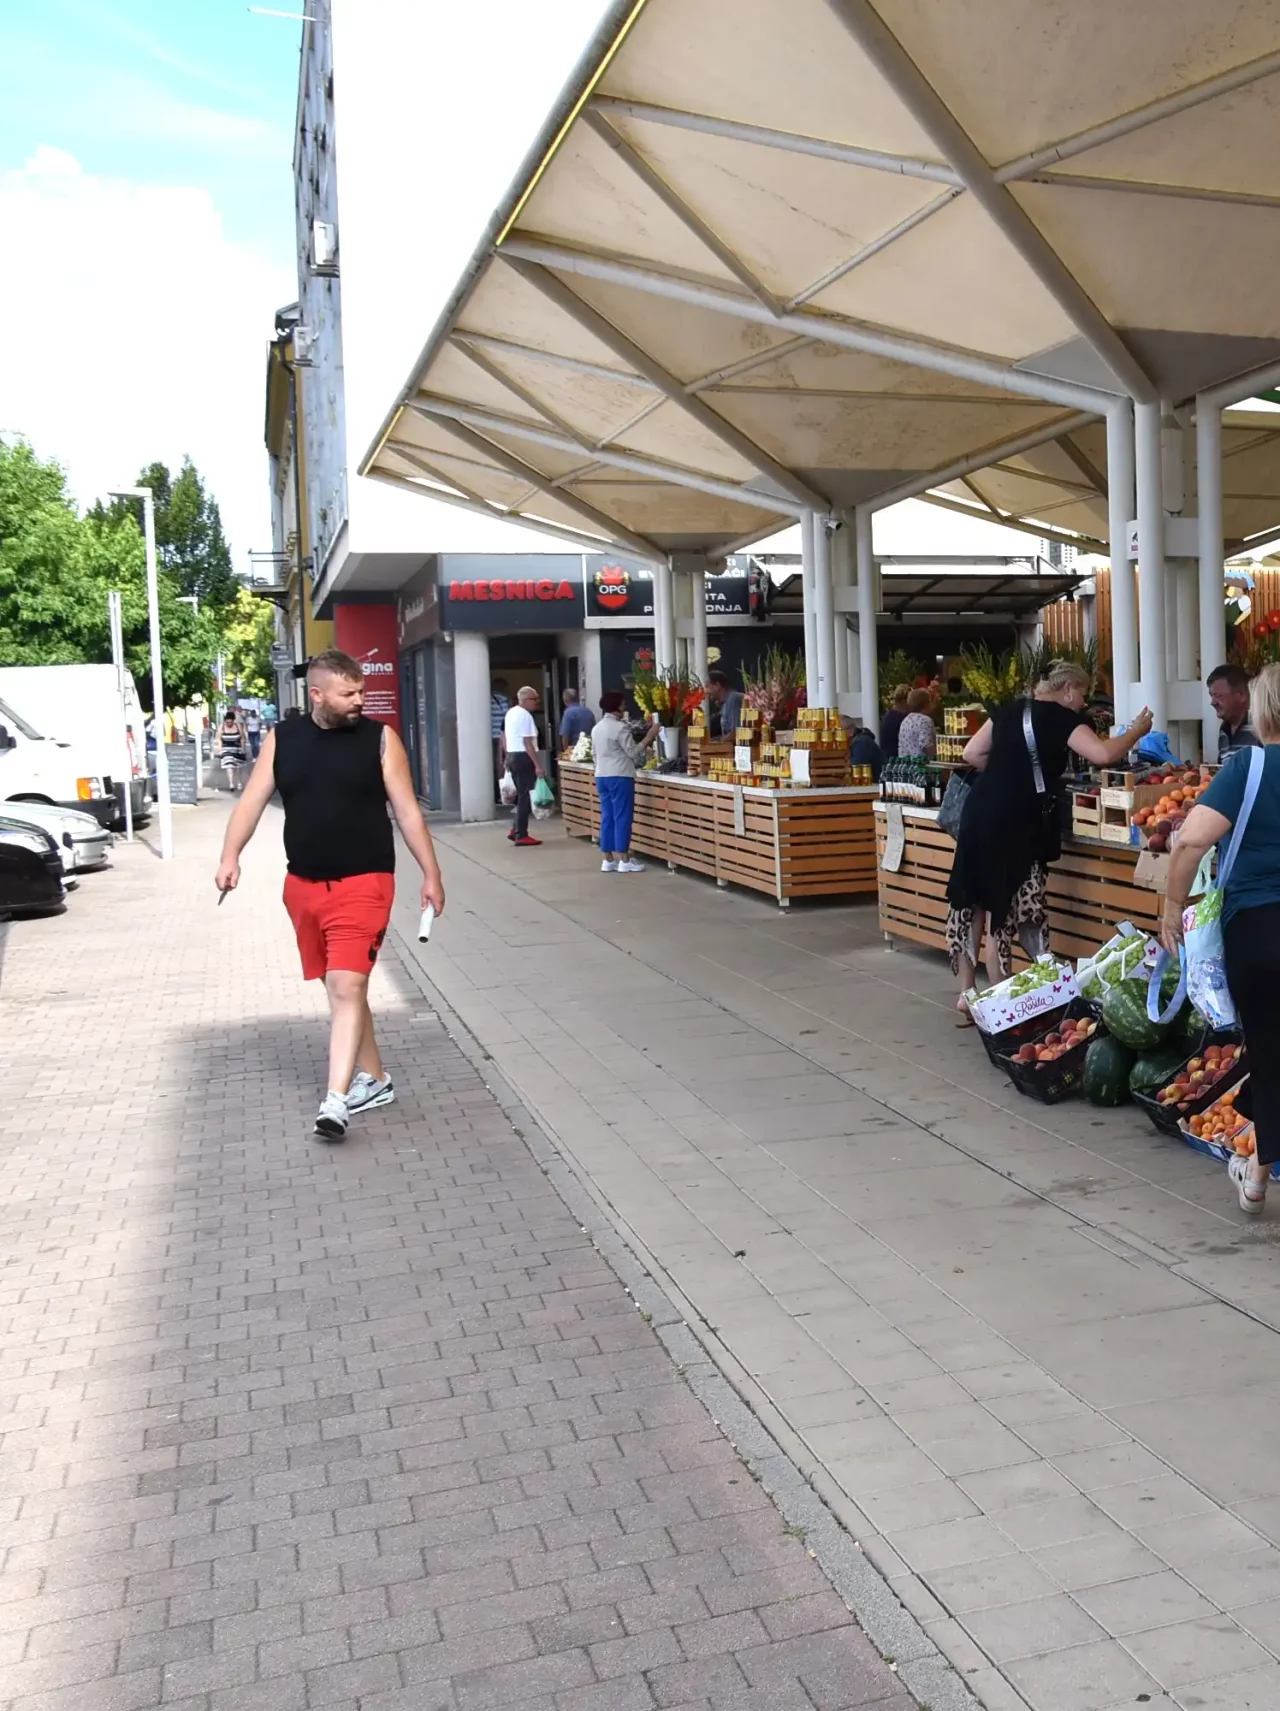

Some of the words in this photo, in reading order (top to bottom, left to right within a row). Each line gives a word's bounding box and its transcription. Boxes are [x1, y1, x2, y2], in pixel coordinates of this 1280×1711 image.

[449, 579, 576, 601] MESNICA
[599, 585, 627, 594] OPG
[361, 662, 394, 676] gina
[1014, 995, 1055, 1018] Rosita
